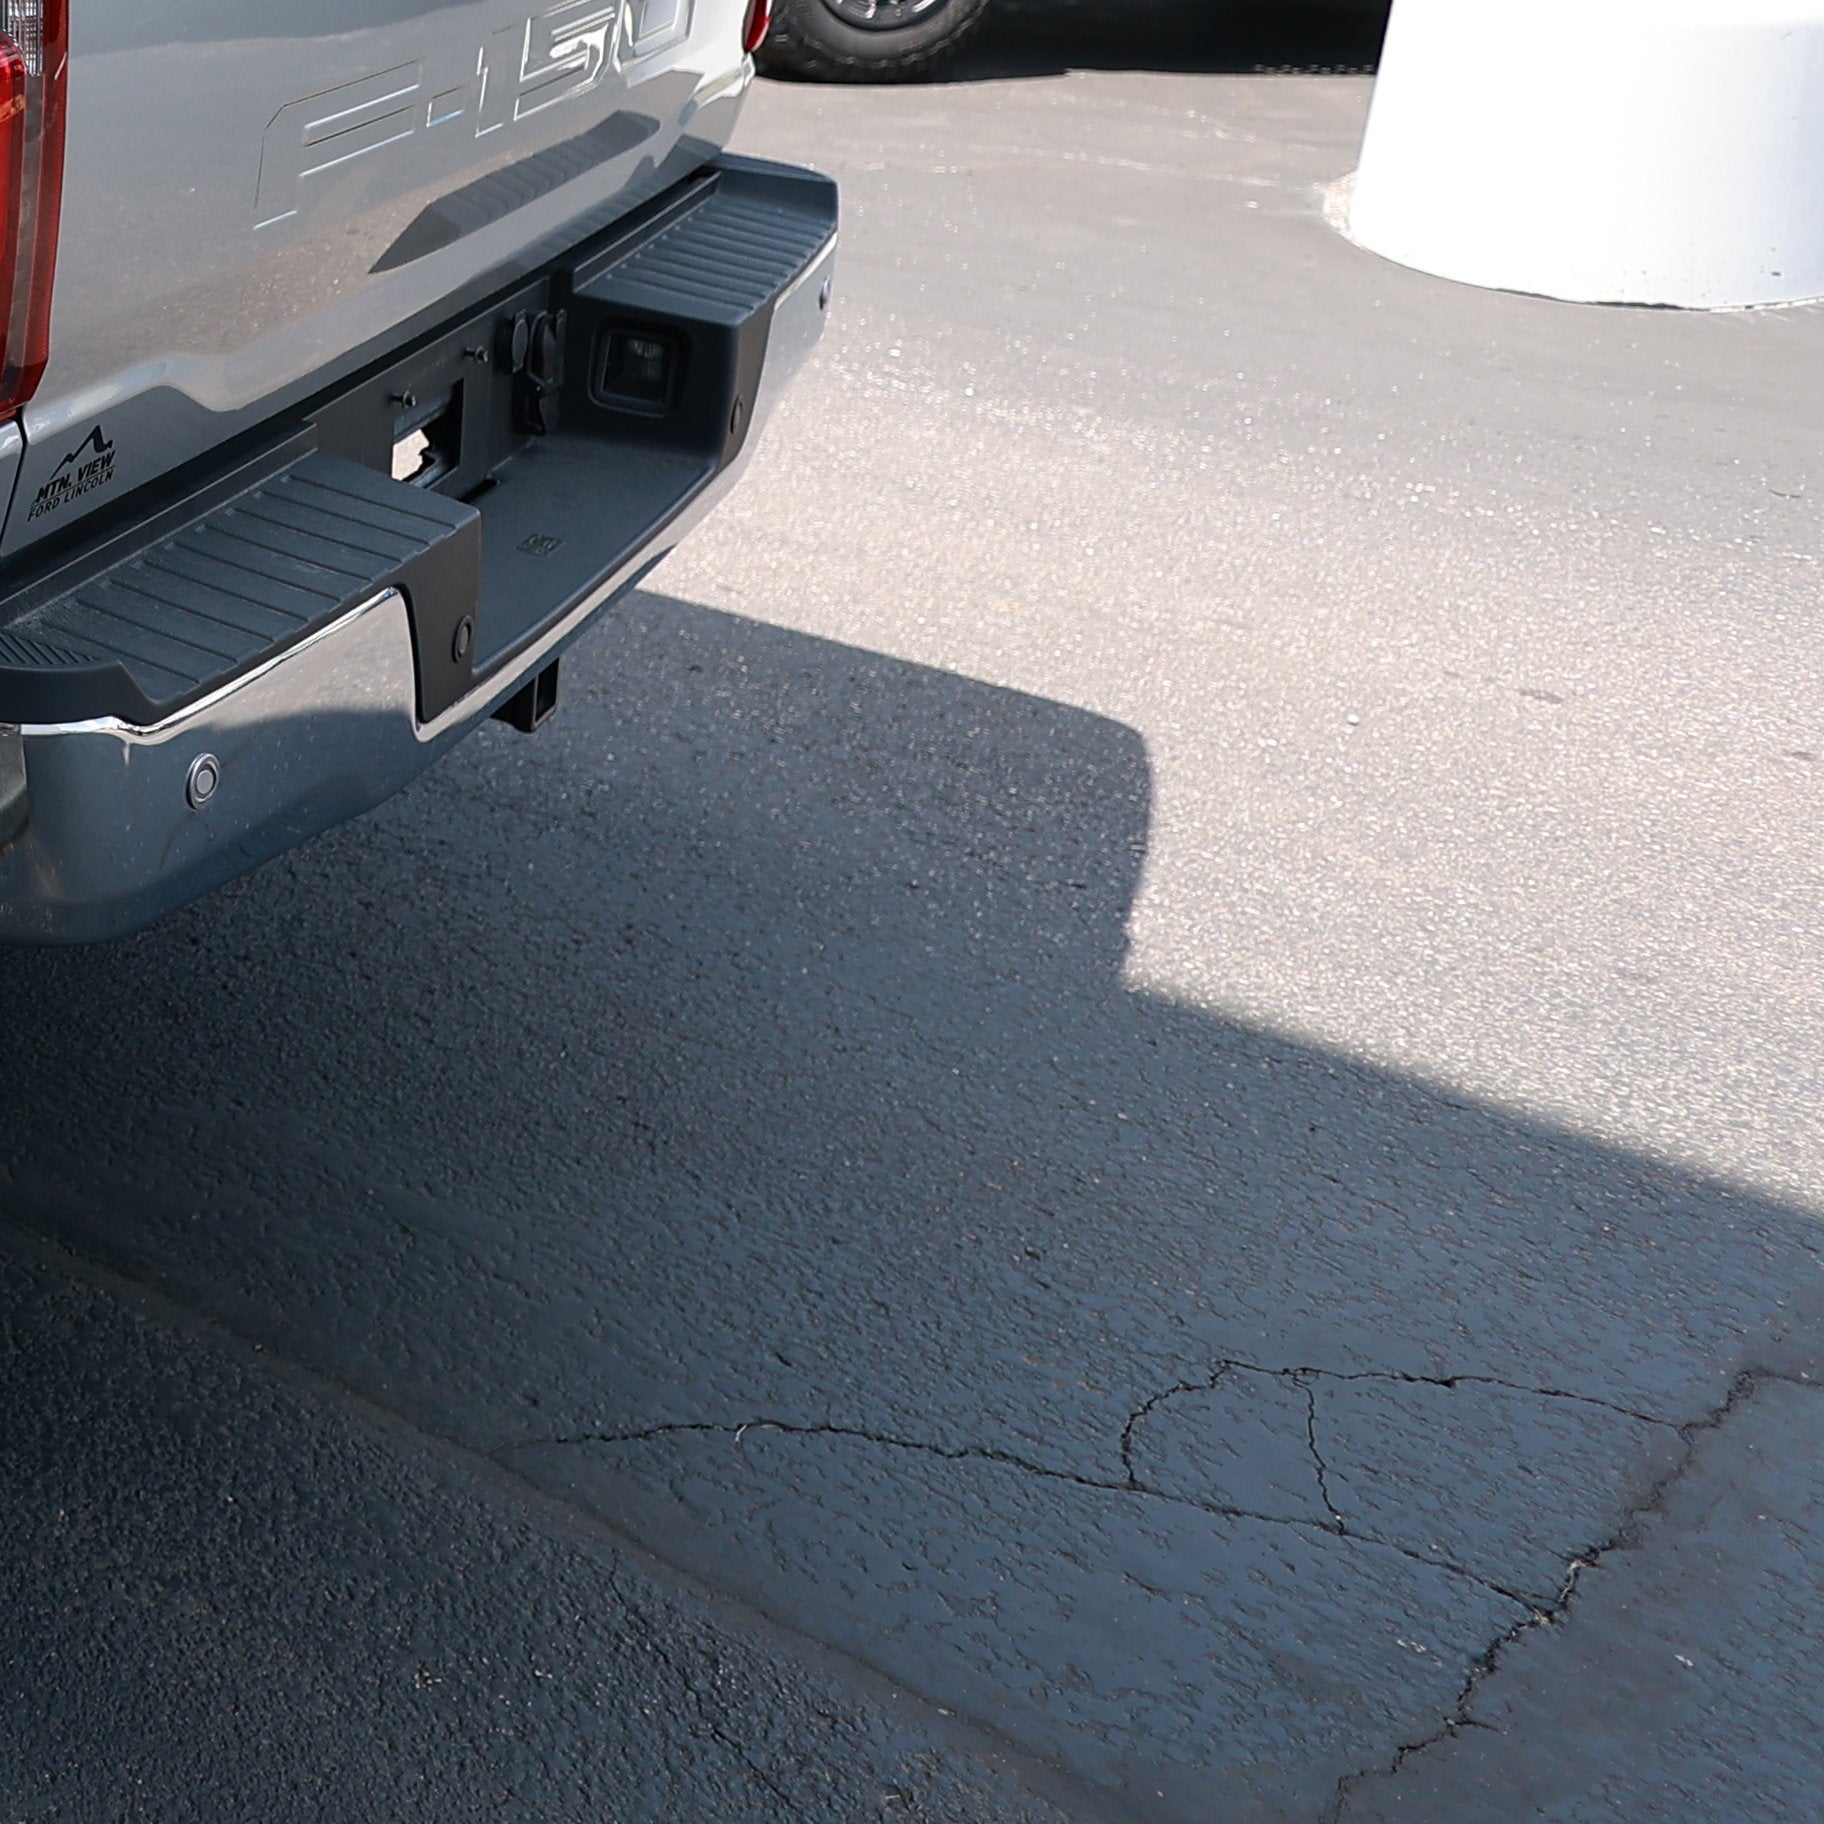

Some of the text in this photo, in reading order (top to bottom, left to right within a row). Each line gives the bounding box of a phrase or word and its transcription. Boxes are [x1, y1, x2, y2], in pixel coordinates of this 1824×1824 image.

[27, 468, 115, 522] FORD LINCOLN
[35, 450, 117, 503] MTN. VIEW
